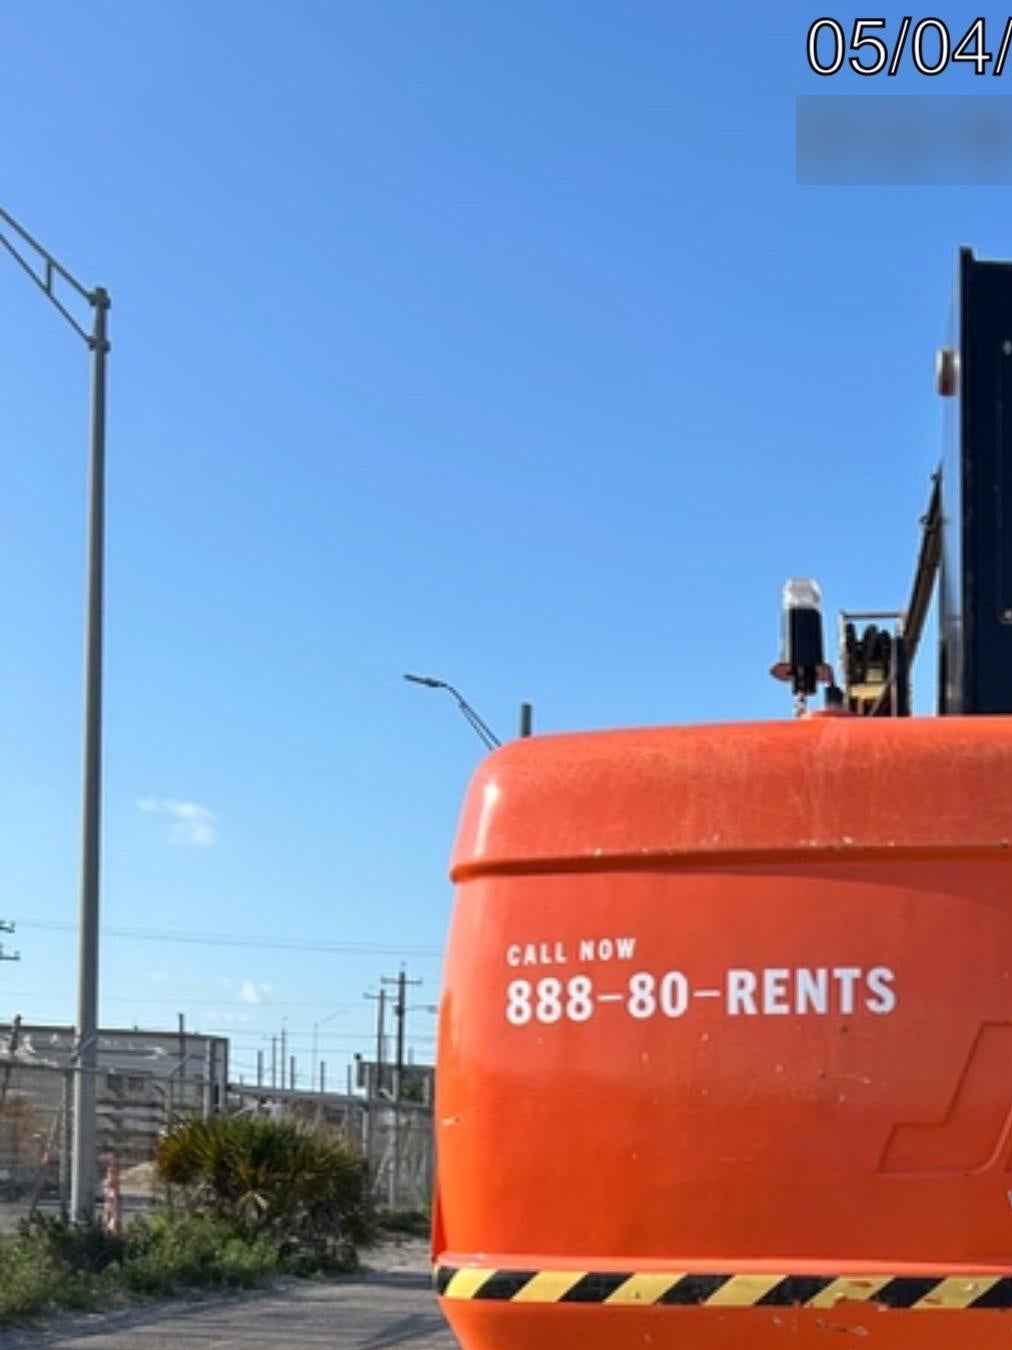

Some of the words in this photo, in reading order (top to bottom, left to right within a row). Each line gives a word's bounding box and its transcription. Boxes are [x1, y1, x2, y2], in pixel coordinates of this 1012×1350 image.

[507, 944, 568, 966] CALL
[580, 938, 637, 960] NOW
[506, 967, 898, 1026] 888-80-RENTS
